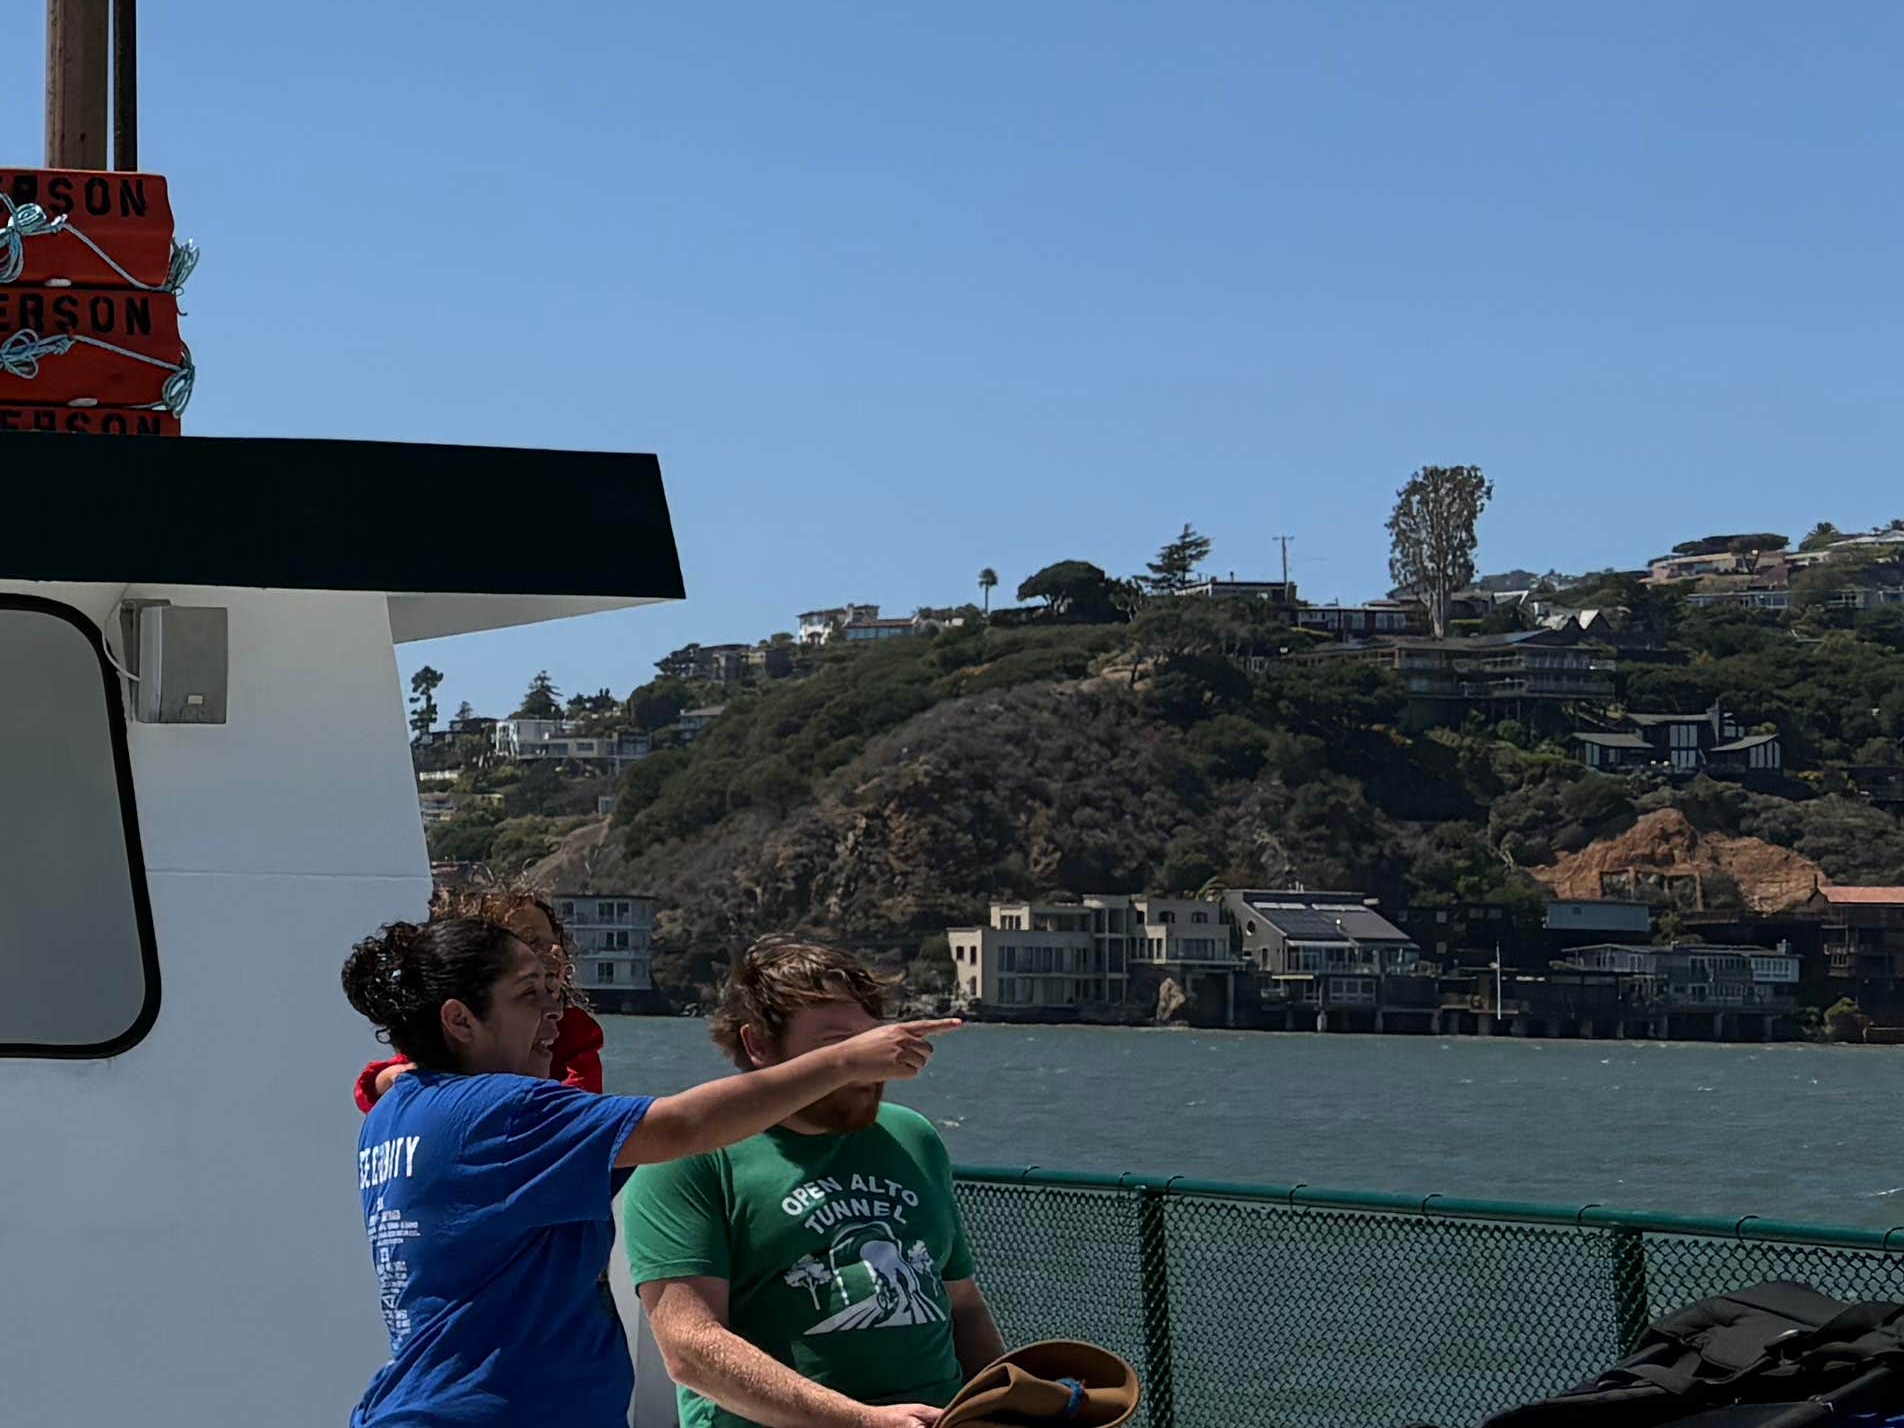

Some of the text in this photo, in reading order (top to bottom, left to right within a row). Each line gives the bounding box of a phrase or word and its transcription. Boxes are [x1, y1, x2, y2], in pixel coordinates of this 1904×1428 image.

[782, 1173, 919, 1216] OPEN ALTO
[804, 1198, 907, 1235] TUNNEL
